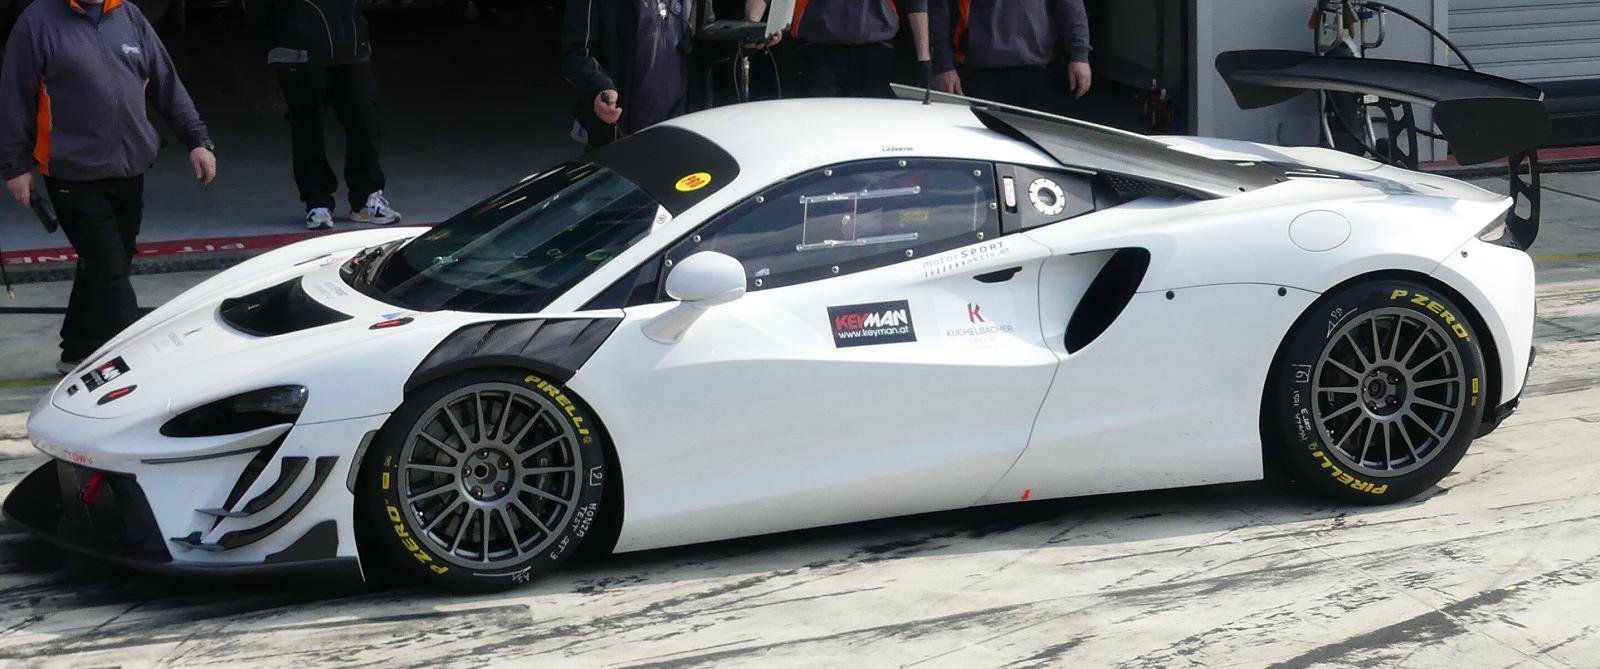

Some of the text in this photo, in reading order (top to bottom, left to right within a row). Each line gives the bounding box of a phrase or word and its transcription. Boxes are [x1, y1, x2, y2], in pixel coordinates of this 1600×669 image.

[176, 242, 245, 253] PIT
[922, 241, 1006, 270] motorSPORT
[834, 308, 909, 331] KEYMAN
[1390, 289, 1469, 341] P ZERO
[838, 325, 910, 340] www.keyman.at
[945, 324, 1015, 336] KUCHELBACHER
[524, 373, 586, 438] PIRELLI
[1313, 449, 1389, 496] PIRELLI
[385, 504, 450, 576] P ZERO
